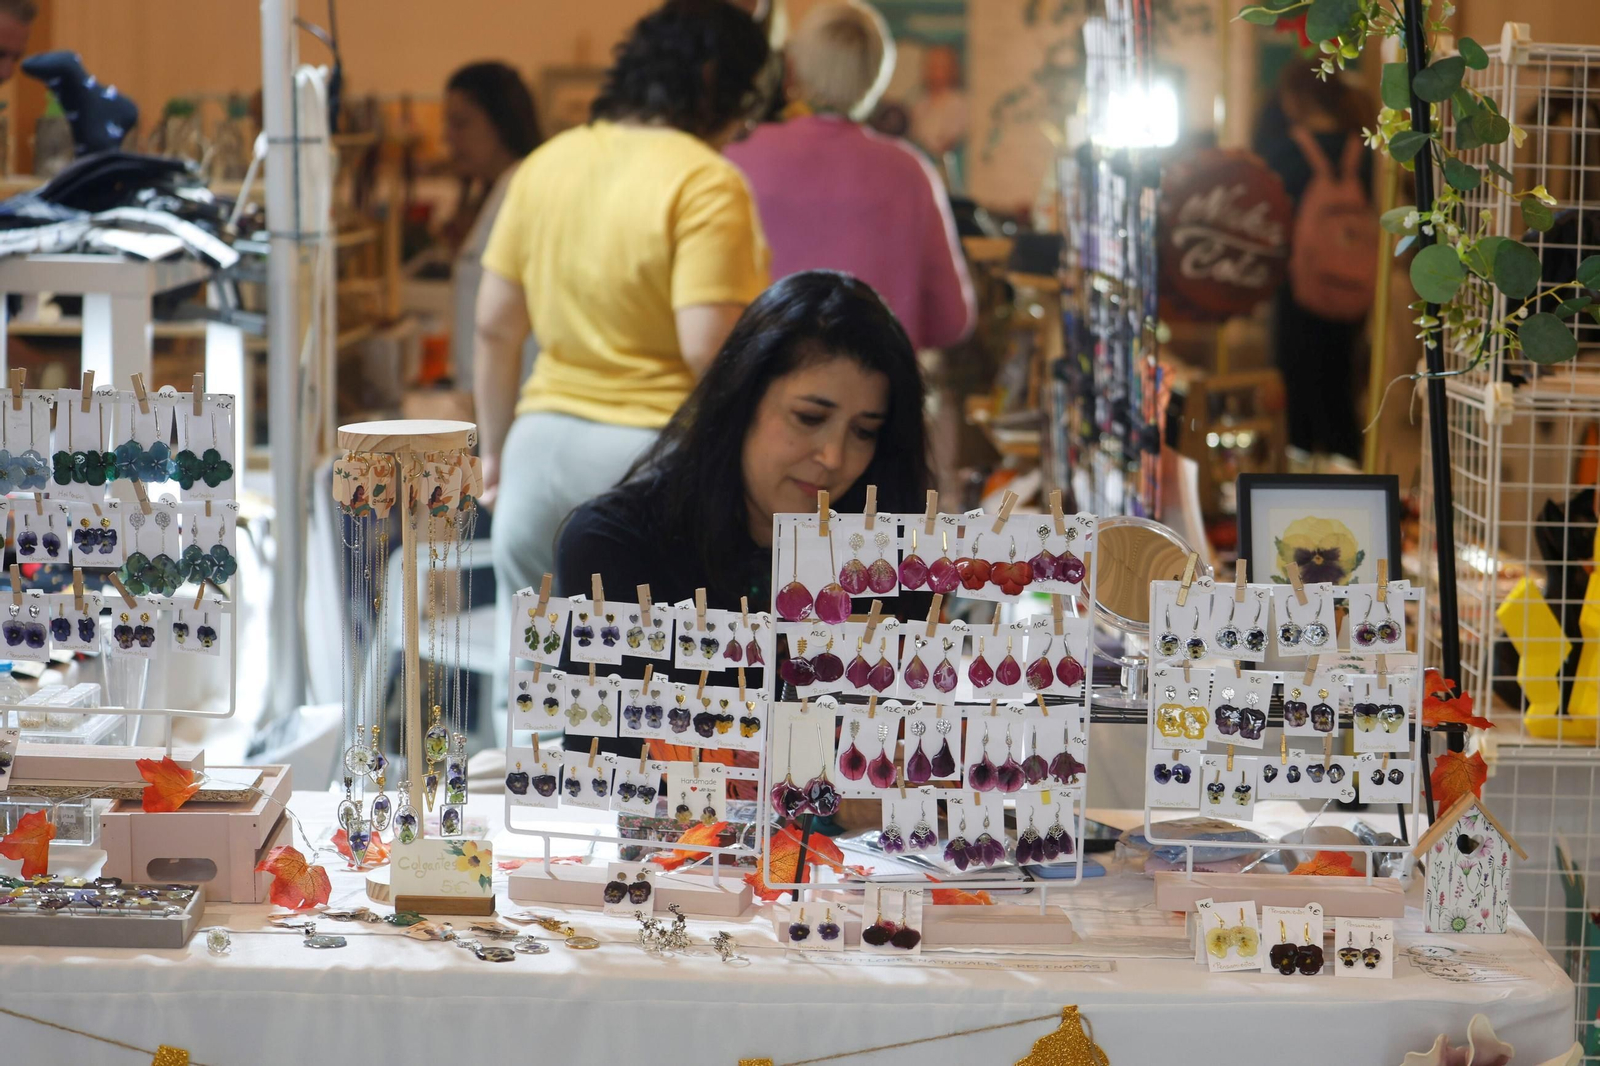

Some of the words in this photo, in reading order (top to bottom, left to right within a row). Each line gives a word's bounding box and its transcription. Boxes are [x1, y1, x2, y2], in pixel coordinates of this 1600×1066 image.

[158, 390, 174, 398] 12€
[942, 516, 956, 525] 12€
[1075, 516, 1093, 528] 12€
[885, 620, 899, 631] 10€
[1033, 619, 1048, 629] 10€
[656, 675, 667, 683] 7€
[1331, 674, 1344, 682] 8€
[756, 692, 768, 701] 7€
[817, 701, 834, 709] 14€
[884, 705, 901, 713] 12€
[908, 702, 922, 715] 10€
[1009, 706, 1024, 715] 12€
[1072, 737, 1087, 745] 10€
[1341, 789, 1354, 797] 5€
[398, 853, 457, 878] Colgantes
[440, 880, 470, 894] 5€
